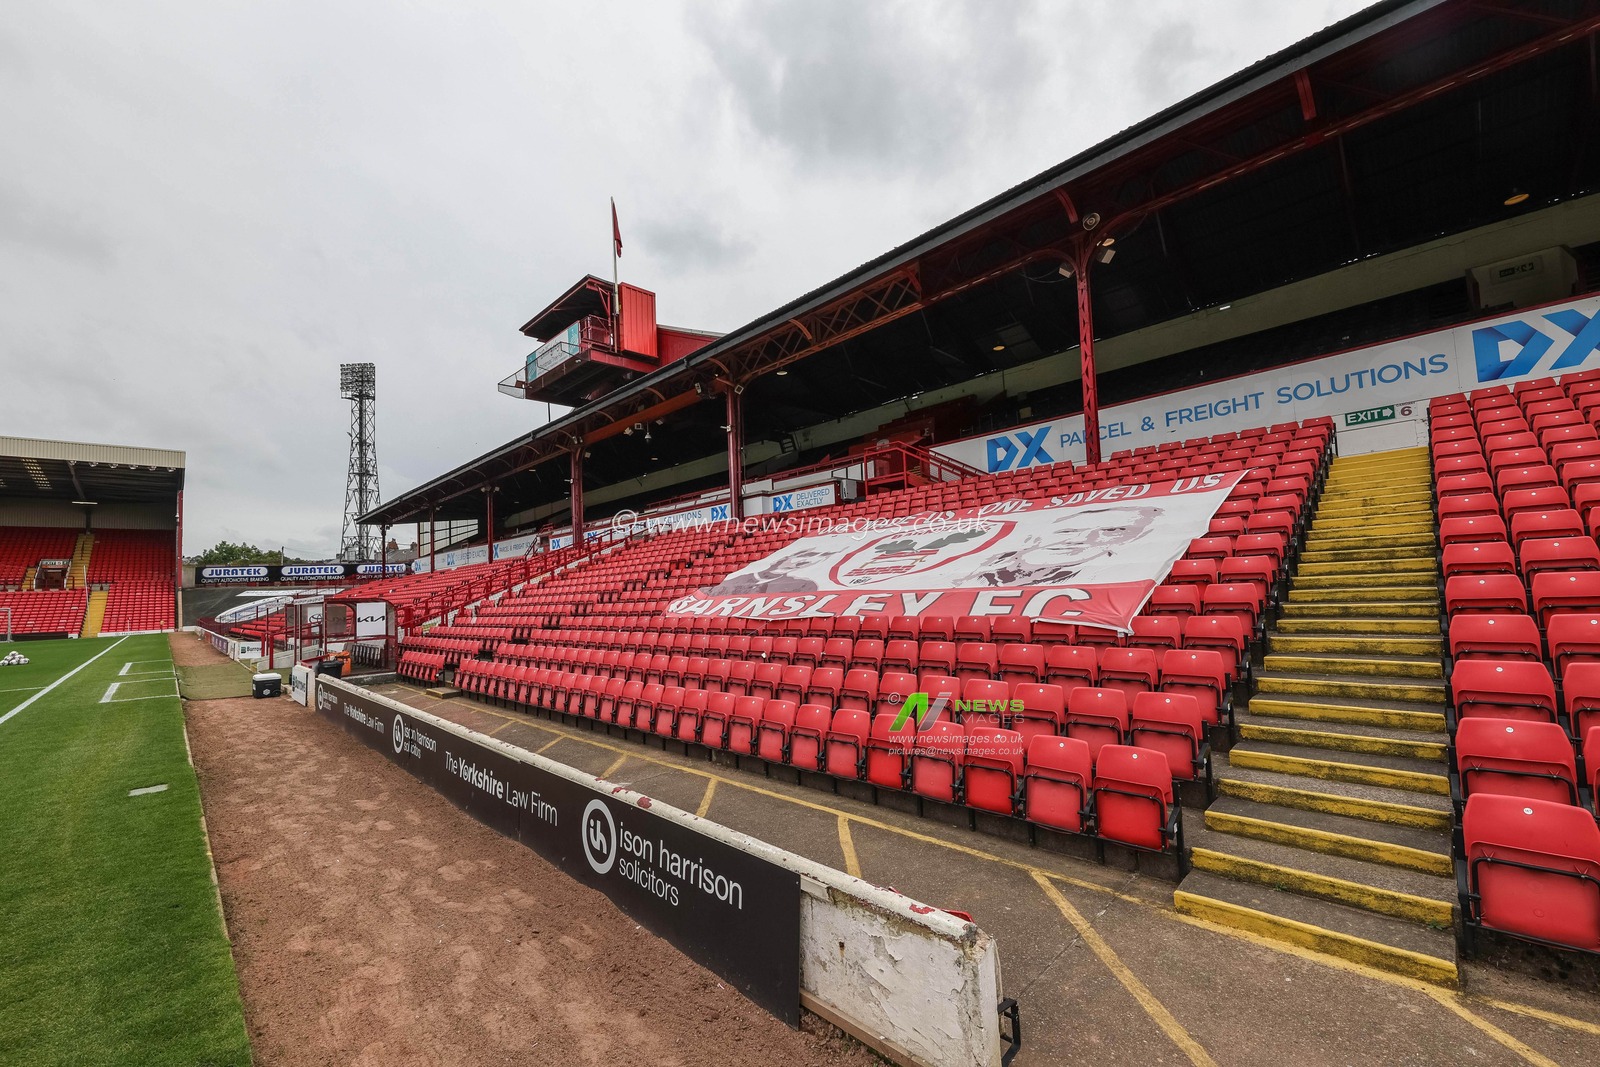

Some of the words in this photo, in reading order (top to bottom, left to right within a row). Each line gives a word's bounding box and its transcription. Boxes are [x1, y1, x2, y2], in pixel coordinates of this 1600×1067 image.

[986, 426, 1055, 473] DX
[1060, 422, 1132, 448] PACEL
[1140, 416, 1156, 431] &
[1165, 392, 1265, 428] FREIGHT
[1276, 353, 1449, 404] SOLUTIONS
[1346, 409, 1381, 424] EXIT
[1400, 406, 1413, 417] 6
[772, 494, 793, 512] DX
[796, 488, 830, 500] DELIVERED
[796, 497, 824, 508] EXACTLY
[1043, 484, 1152, 509] SAVED
[1169, 473, 1227, 494] US
[711, 505, 728, 521] DX
[208, 568, 261, 576] JURATEK
[287, 566, 338, 575] JURATEK
[416, 728, 437, 753] harrison
[445, 751, 458, 775] The
[458, 757, 504, 800] Yorkshire
[505, 781, 529, 810] Law
[531, 791, 558, 827] Firm
[619, 821, 653, 863] ison
[659, 840, 743, 910] harrison
[618, 858, 680, 907] solicitors
